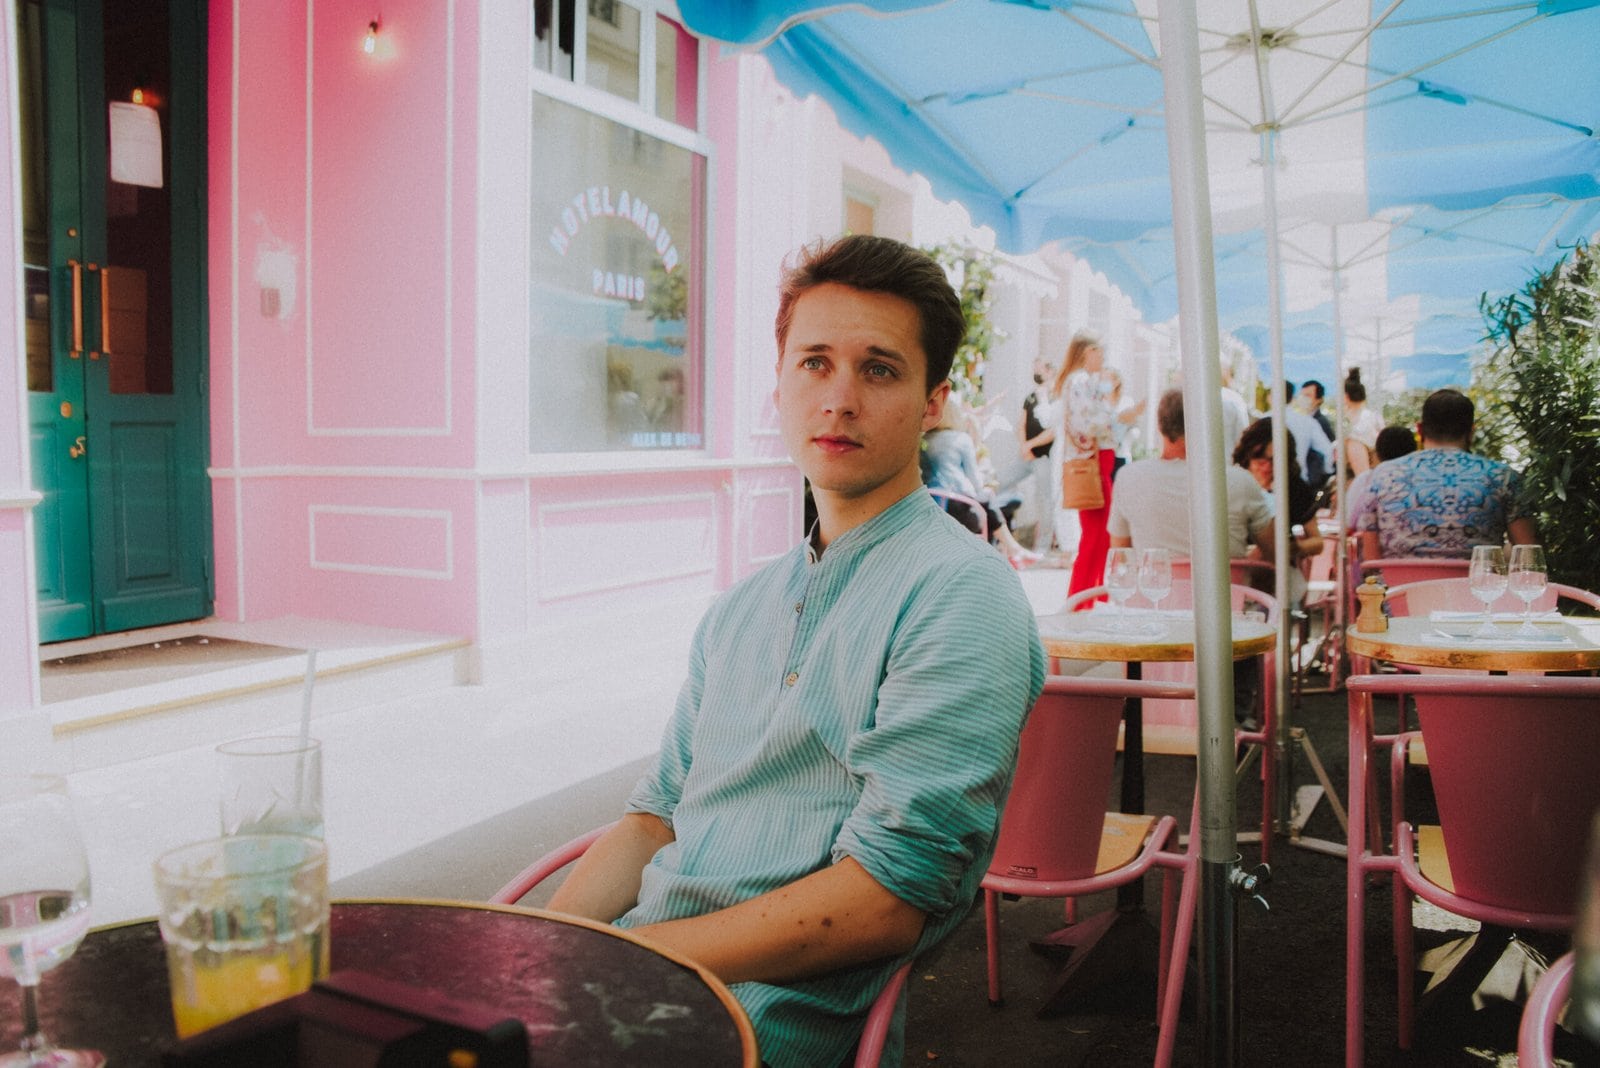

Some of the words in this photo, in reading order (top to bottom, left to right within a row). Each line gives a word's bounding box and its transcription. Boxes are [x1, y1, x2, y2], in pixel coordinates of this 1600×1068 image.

[549, 186, 614, 256] HOTEL
[617, 190, 679, 273] AMOUR
[592, 268, 645, 302] PARIS
